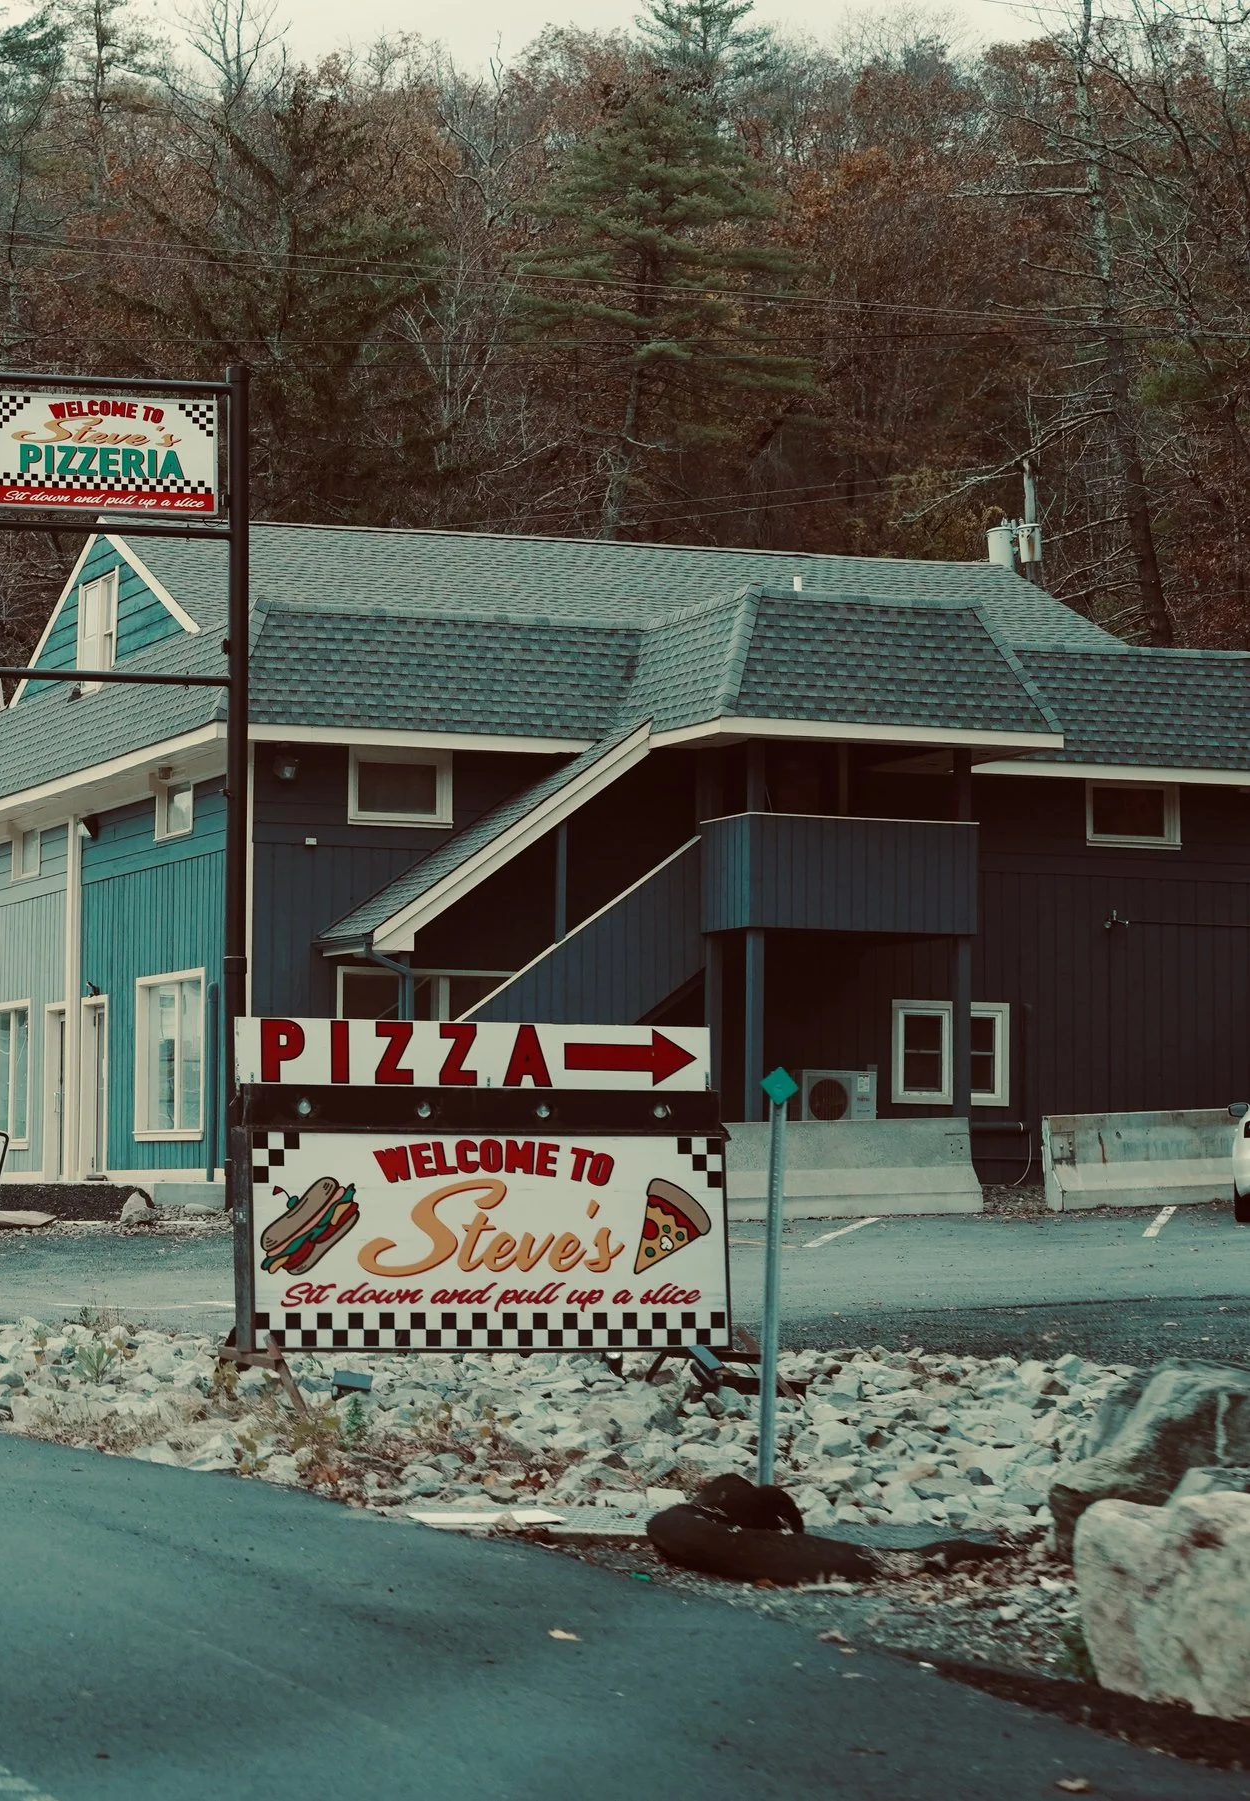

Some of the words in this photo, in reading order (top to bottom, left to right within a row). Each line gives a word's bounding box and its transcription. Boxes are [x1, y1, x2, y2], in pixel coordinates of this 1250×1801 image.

[48, 400, 138, 420] WELCOME
[143, 405, 165, 424] TO
[11, 416, 182, 448] Steve's
[19, 444, 185, 480] PIZZERIA
[3, 490, 29, 502] Sit
[30, 490, 71, 502] down
[74, 493, 104, 505] and
[103, 494, 136, 507] pull
[137, 497, 158, 509] up
[160, 499, 171, 507] a
[174, 497, 205, 508] slice
[260, 1018, 553, 1087] PIZZA
[373, 1138, 560, 1183] WELCOME
[570, 1146, 615, 1187] TO
[357, 1178, 625, 1278] Steve's
[280, 1282, 336, 1308] Sit
[336, 1282, 423, 1306] down
[430, 1282, 499, 1306] and
[494, 1282, 560, 1312] pull
[566, 1289, 605, 1313] up
[612, 1289, 633, 1305] a
[640, 1282, 702, 1306] slice
